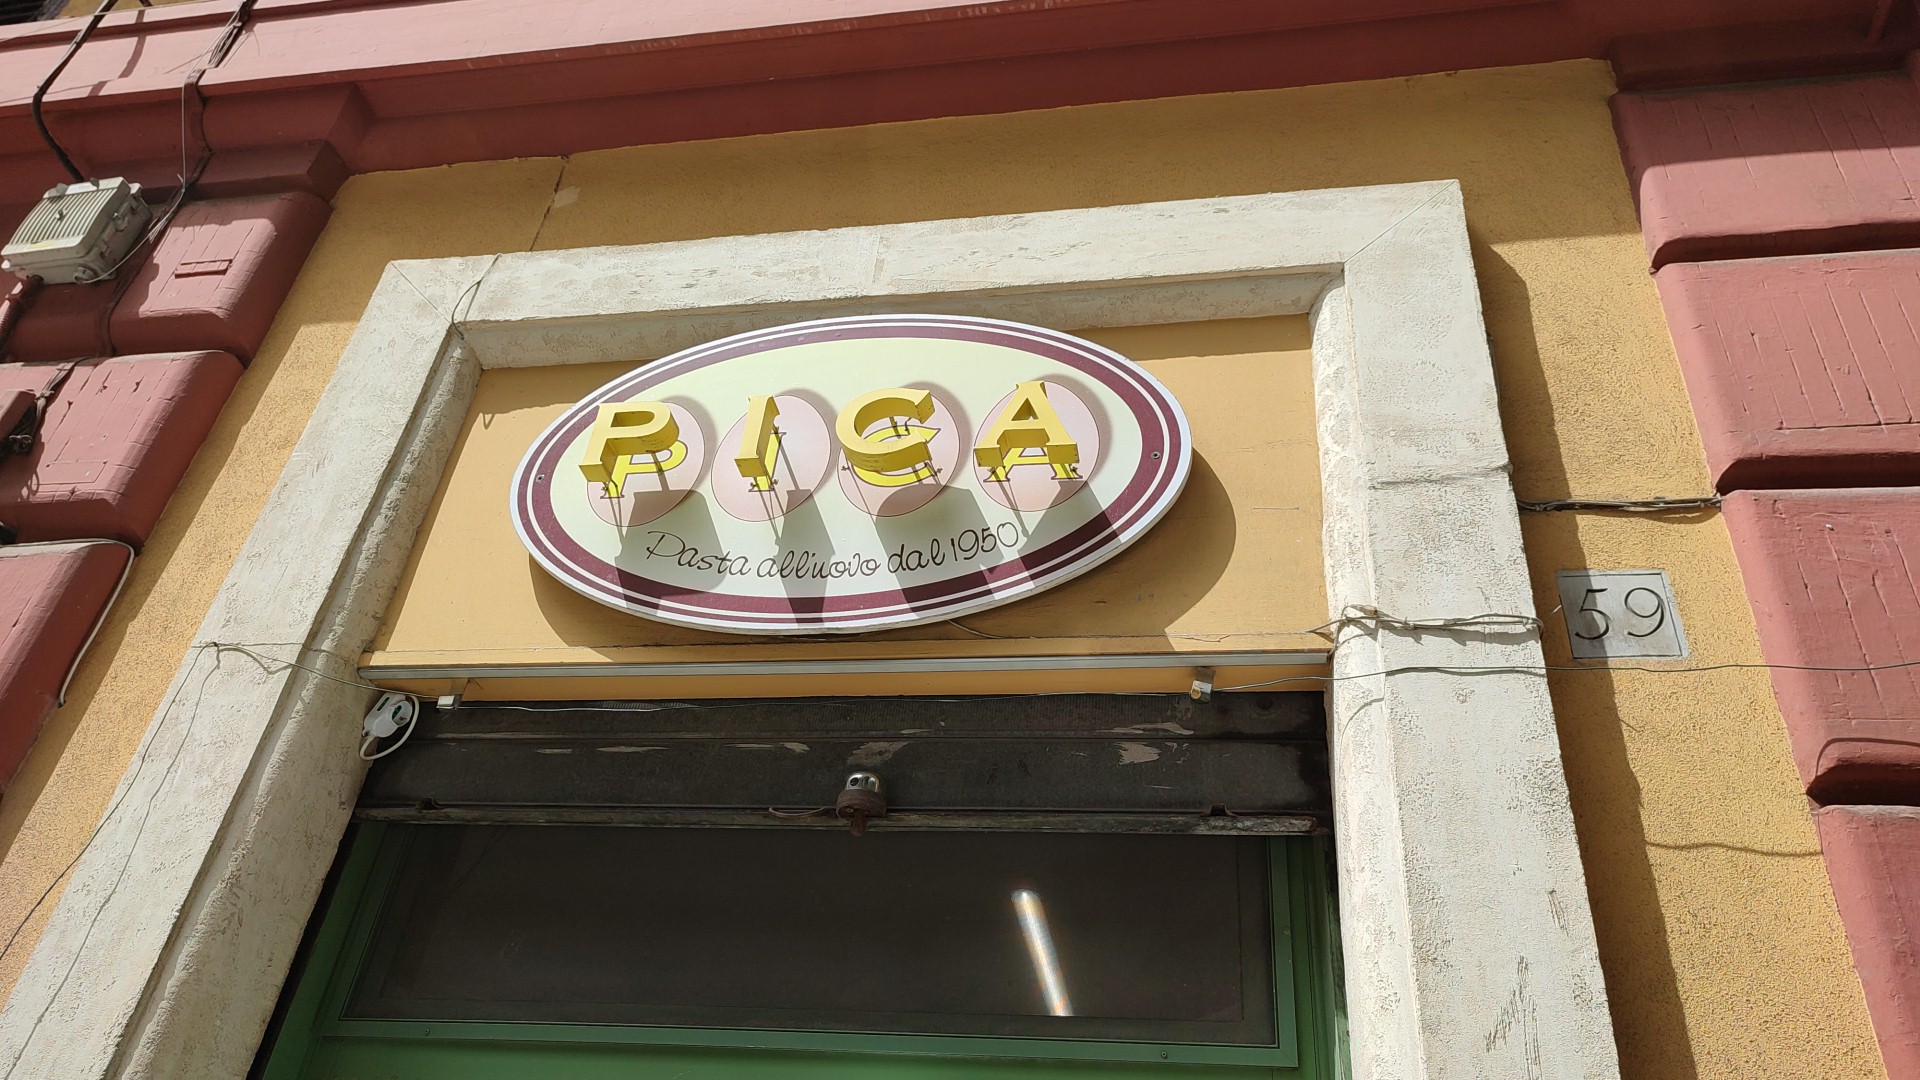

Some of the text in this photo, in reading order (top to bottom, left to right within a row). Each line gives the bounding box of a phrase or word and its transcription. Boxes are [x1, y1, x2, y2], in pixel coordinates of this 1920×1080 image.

[577, 380, 1080, 484] PICA
[646, 522, 1020, 579] Pasta all'uovo dal 1950
[1574, 586, 1666, 641] 59
